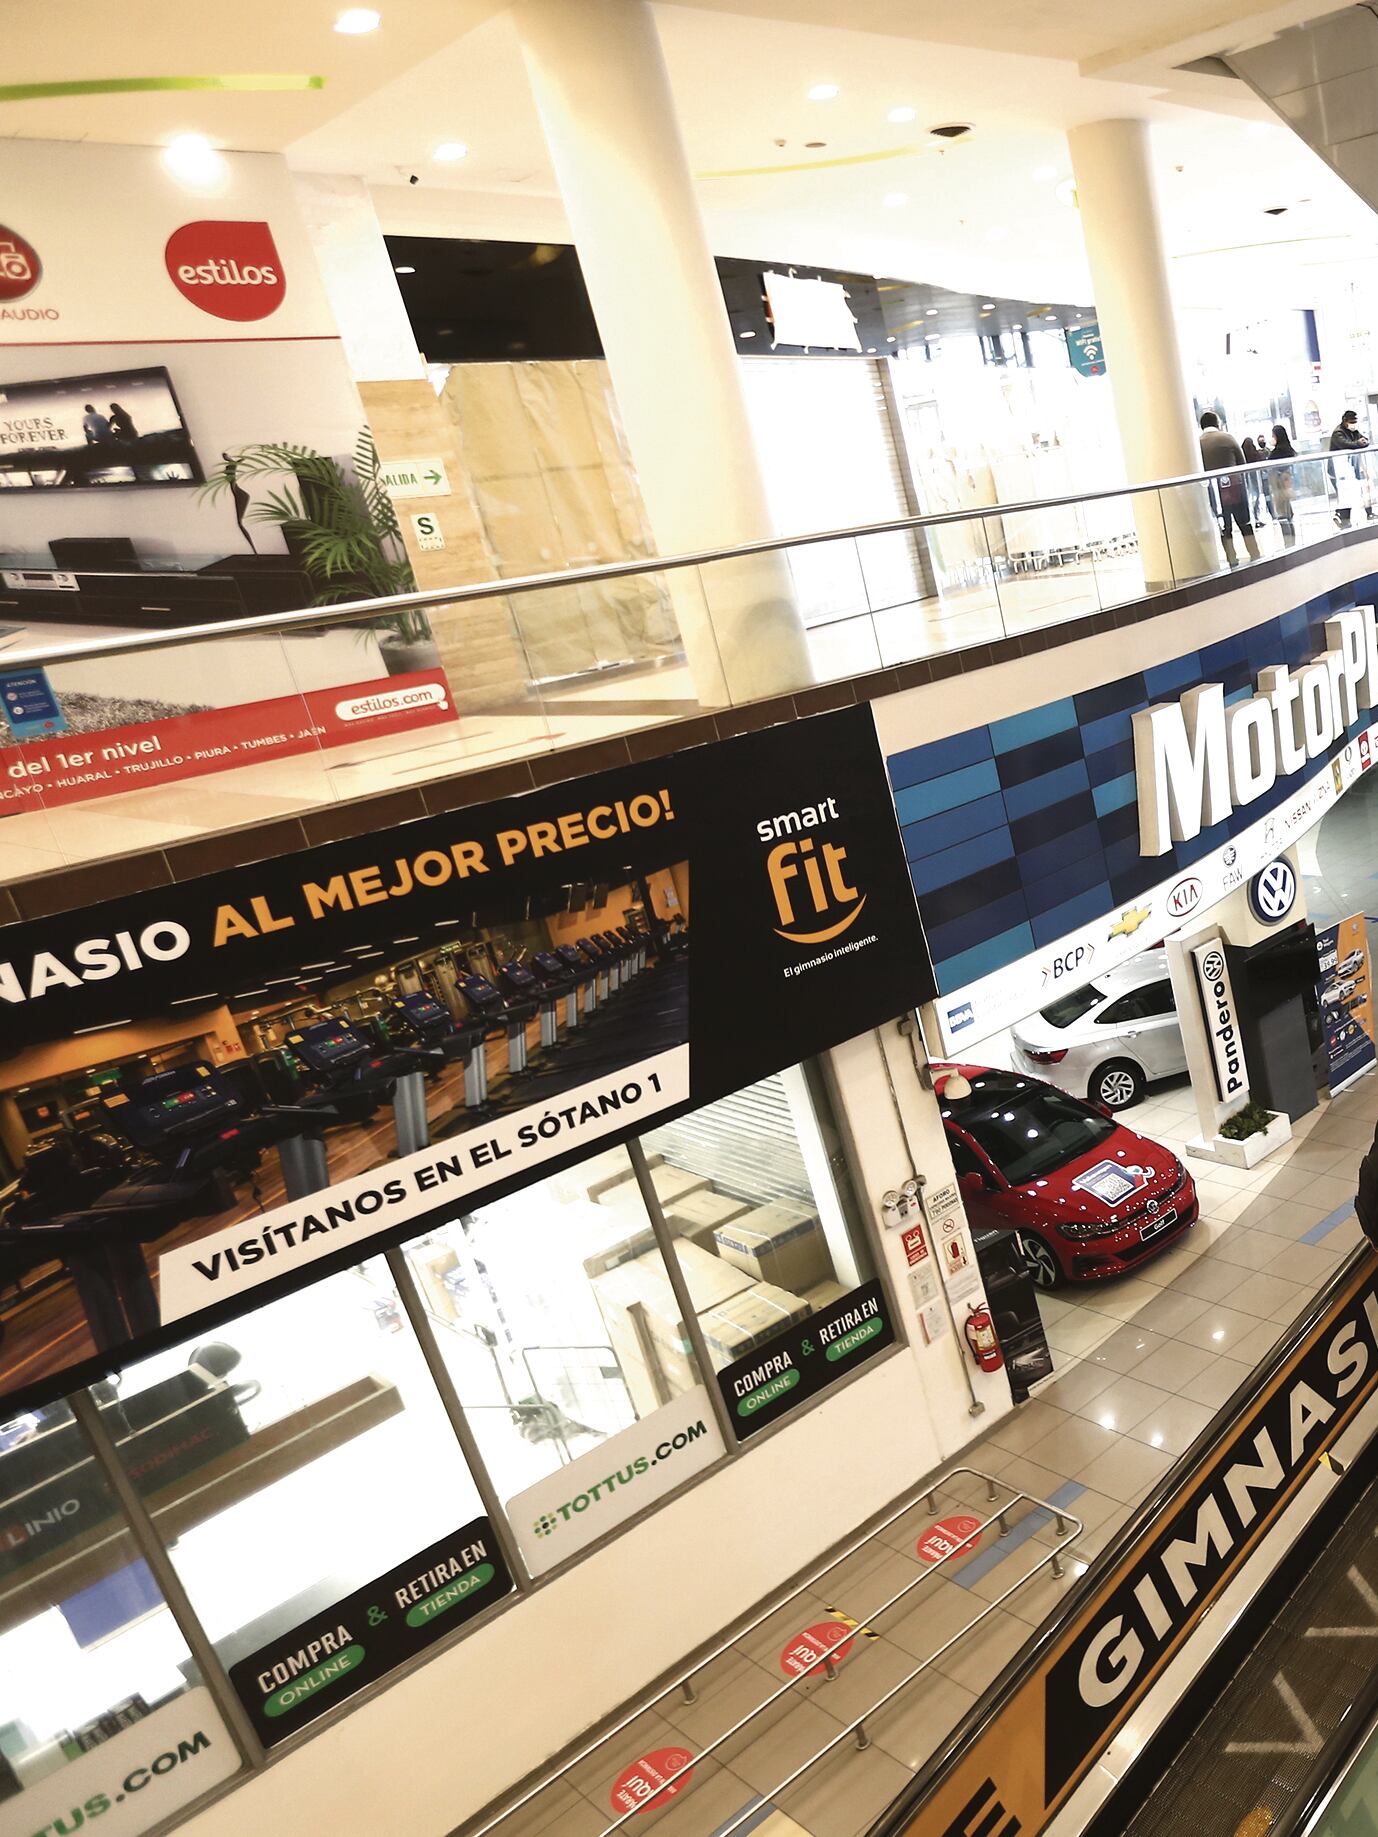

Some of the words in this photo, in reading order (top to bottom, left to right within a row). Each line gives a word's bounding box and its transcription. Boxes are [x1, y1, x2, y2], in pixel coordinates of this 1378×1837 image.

[177, 258, 278, 287] estilos
[1, 429, 68, 445] FOREVER
[3, 417, 54, 432] YOURS
[384, 473, 418, 486] ALIDA
[417, 516, 434, 535] S
[350, 687, 434, 716] estilos.com
[8, 757, 53, 779] del
[57, 748, 95, 771] 1er
[102, 735, 162, 765] nivel
[57, 769, 113, 788] HUARAL
[124, 755, 184, 775] TRUJILLO
[195, 745, 232, 762] PIURA
[240, 732, 288, 750] TUMBES
[756, 797, 840, 842] smart
[212, 895, 295, 947] AL
[302, 840, 490, 919] MEJOR
[496, 789, 676, 867] PRECIO!
[767, 837, 858, 926] fit
[1172, 883, 1199, 908] KIA
[783, 968, 793, 978] El
[793, 951, 834, 976] gimnasio
[833, 934, 879, 957] inteligente.
[1052, 946, 1085, 980] BCP
[1213, 980, 1243, 1094] Pandero
[192, 1180, 407, 1282] VISÍTANOS
[416, 1154, 464, 1192] EN
[470, 1138, 512, 1169] EL
[517, 1085, 643, 1150] SÓTANO
[647, 1072, 663, 1093] 1
[733, 1350, 792, 1398] COMPRA
[801, 1338, 815, 1356] &
[819, 1309, 863, 1345] RETIRA
[861, 1297, 879, 1320] EN
[746, 1375, 791, 1409] ONLINE
[833, 1325, 874, 1354] TIENDA
[556, 1420, 708, 1521] TOTTUS.COM
[257, 1624, 354, 1695] COMPRA
[366, 1605, 389, 1627] &
[394, 1557, 463, 1609] RETIRA
[461, 1539, 488, 1569] EN
[279, 1655, 352, 1707] ONLINE
[419, 1574, 481, 1617] TIENDA
[788, 1644, 817, 1663] QUÍ
